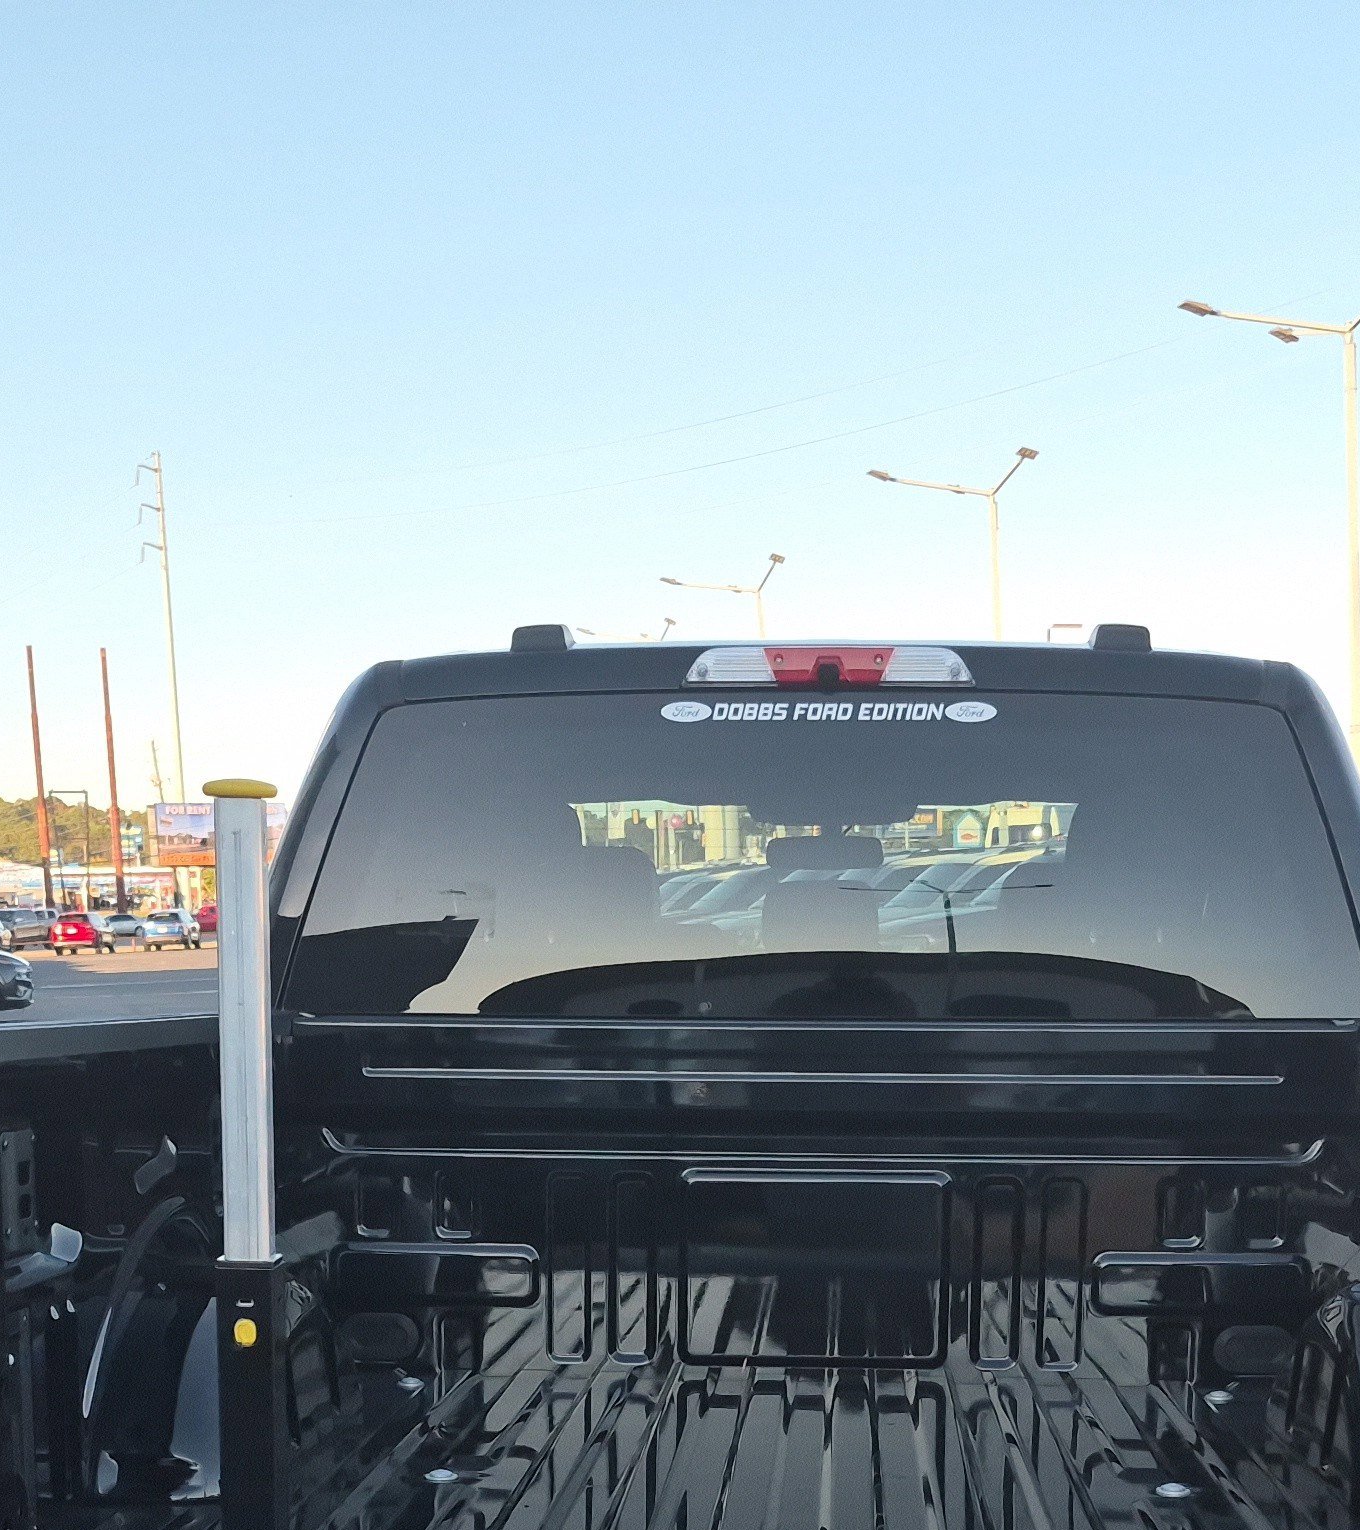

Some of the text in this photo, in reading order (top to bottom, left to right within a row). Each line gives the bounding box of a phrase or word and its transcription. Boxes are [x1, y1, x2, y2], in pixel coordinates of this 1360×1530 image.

[712, 702, 789, 721] DOBBS
[793, 702, 854, 721] FORD
[857, 702, 945, 721] EDITION
[165, 805, 211, 816] FOR RENT
